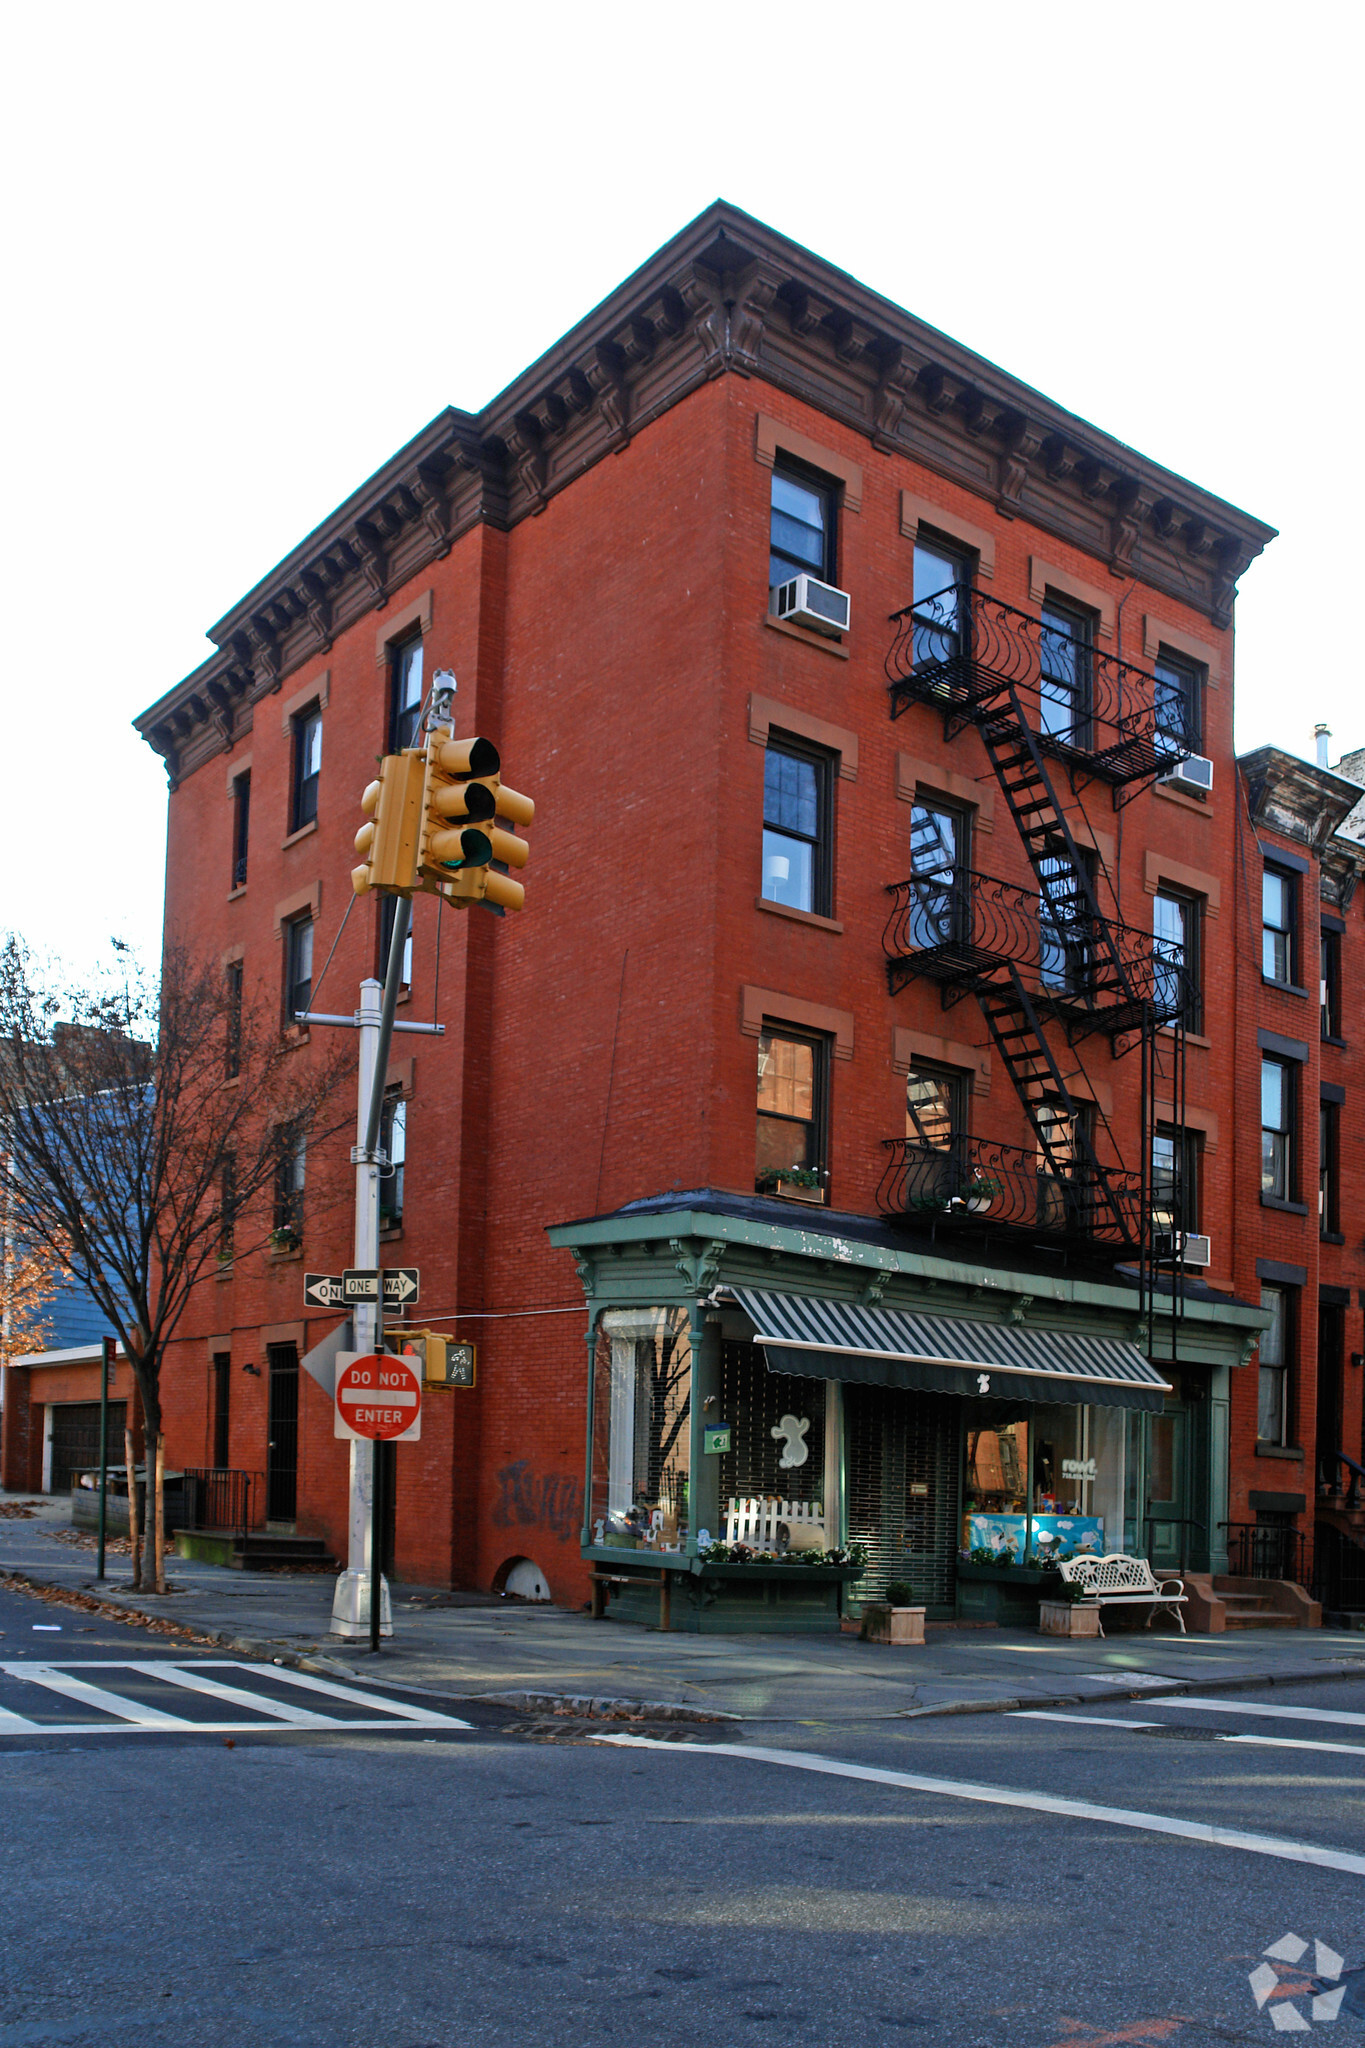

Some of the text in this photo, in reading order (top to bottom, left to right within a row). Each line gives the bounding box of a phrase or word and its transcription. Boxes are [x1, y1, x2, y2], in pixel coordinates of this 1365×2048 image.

[349, 1280, 408, 1293] ONE WAY
[351, 1370, 409, 1387] DO NOT
[355, 1409, 402, 1423] ENTER
